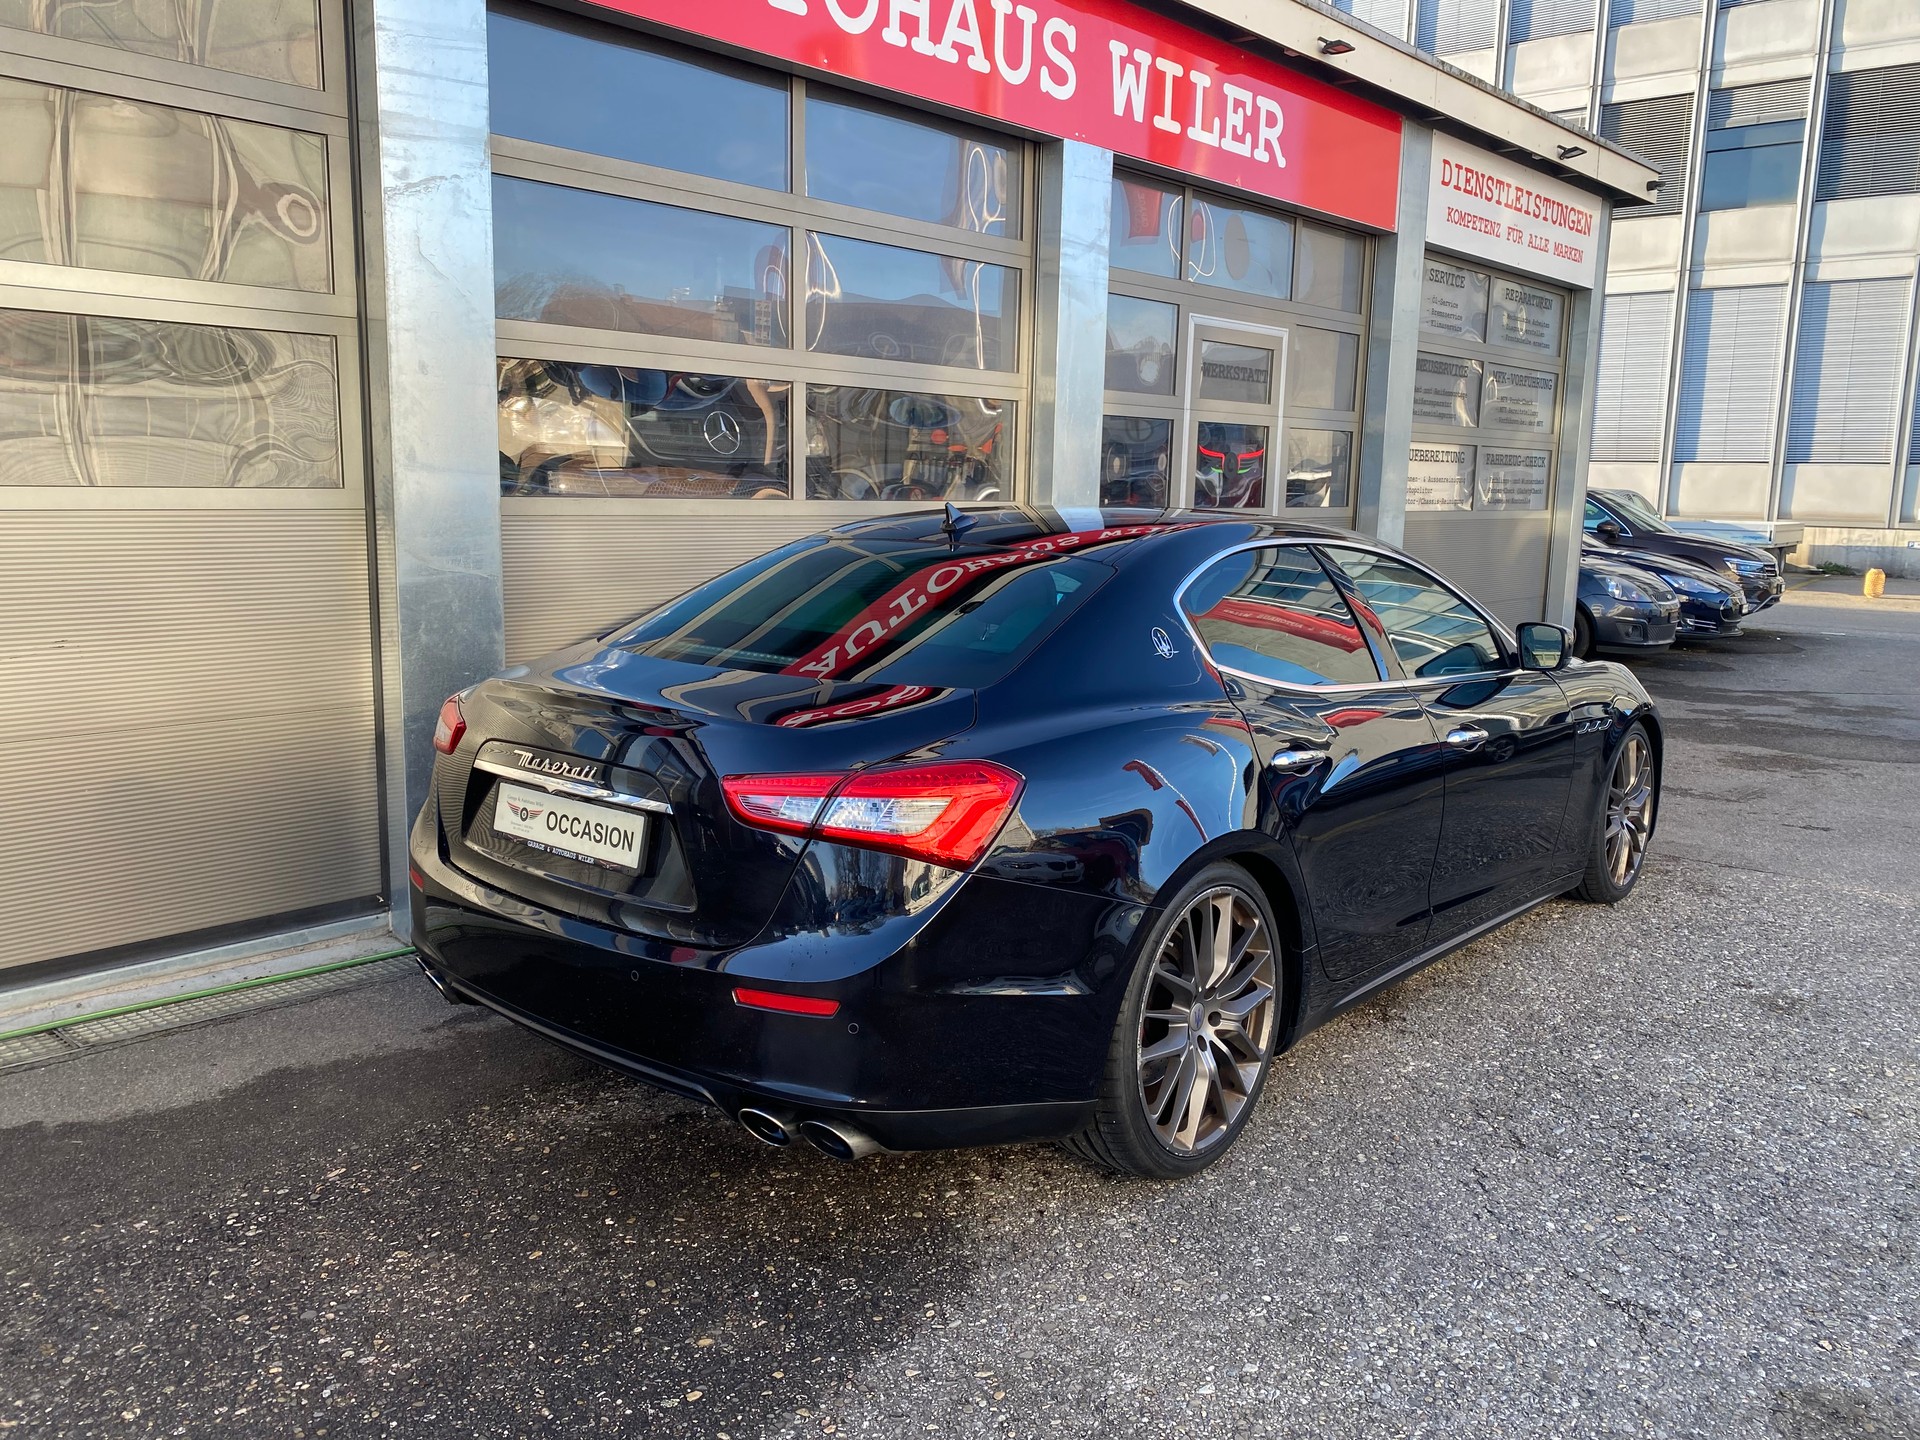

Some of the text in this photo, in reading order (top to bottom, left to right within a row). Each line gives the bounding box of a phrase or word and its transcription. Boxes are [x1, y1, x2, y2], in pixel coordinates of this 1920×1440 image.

[1109, 39, 1286, 168] WILER
[1441, 159, 1593, 237] DIENSTLEISTUNGEN
[1447, 206, 1584, 264] KOMPETENZ FÜR ALLE MARKEN
[1429, 268, 1466, 289] SERVICE
[1505, 288, 1553, 310] REPARATUREN
[1203, 362, 1269, 384] WERKSTATT
[1486, 453, 1547, 468] FAHRZEUG-CHECK
[514, 750, 604, 785] Maserati
[546, 811, 635, 853] OCCASION
[527, 840, 545, 851] GARAGE
[551, 847, 577, 860] AUTOHAUS
[578, 854, 595, 865] WILER
